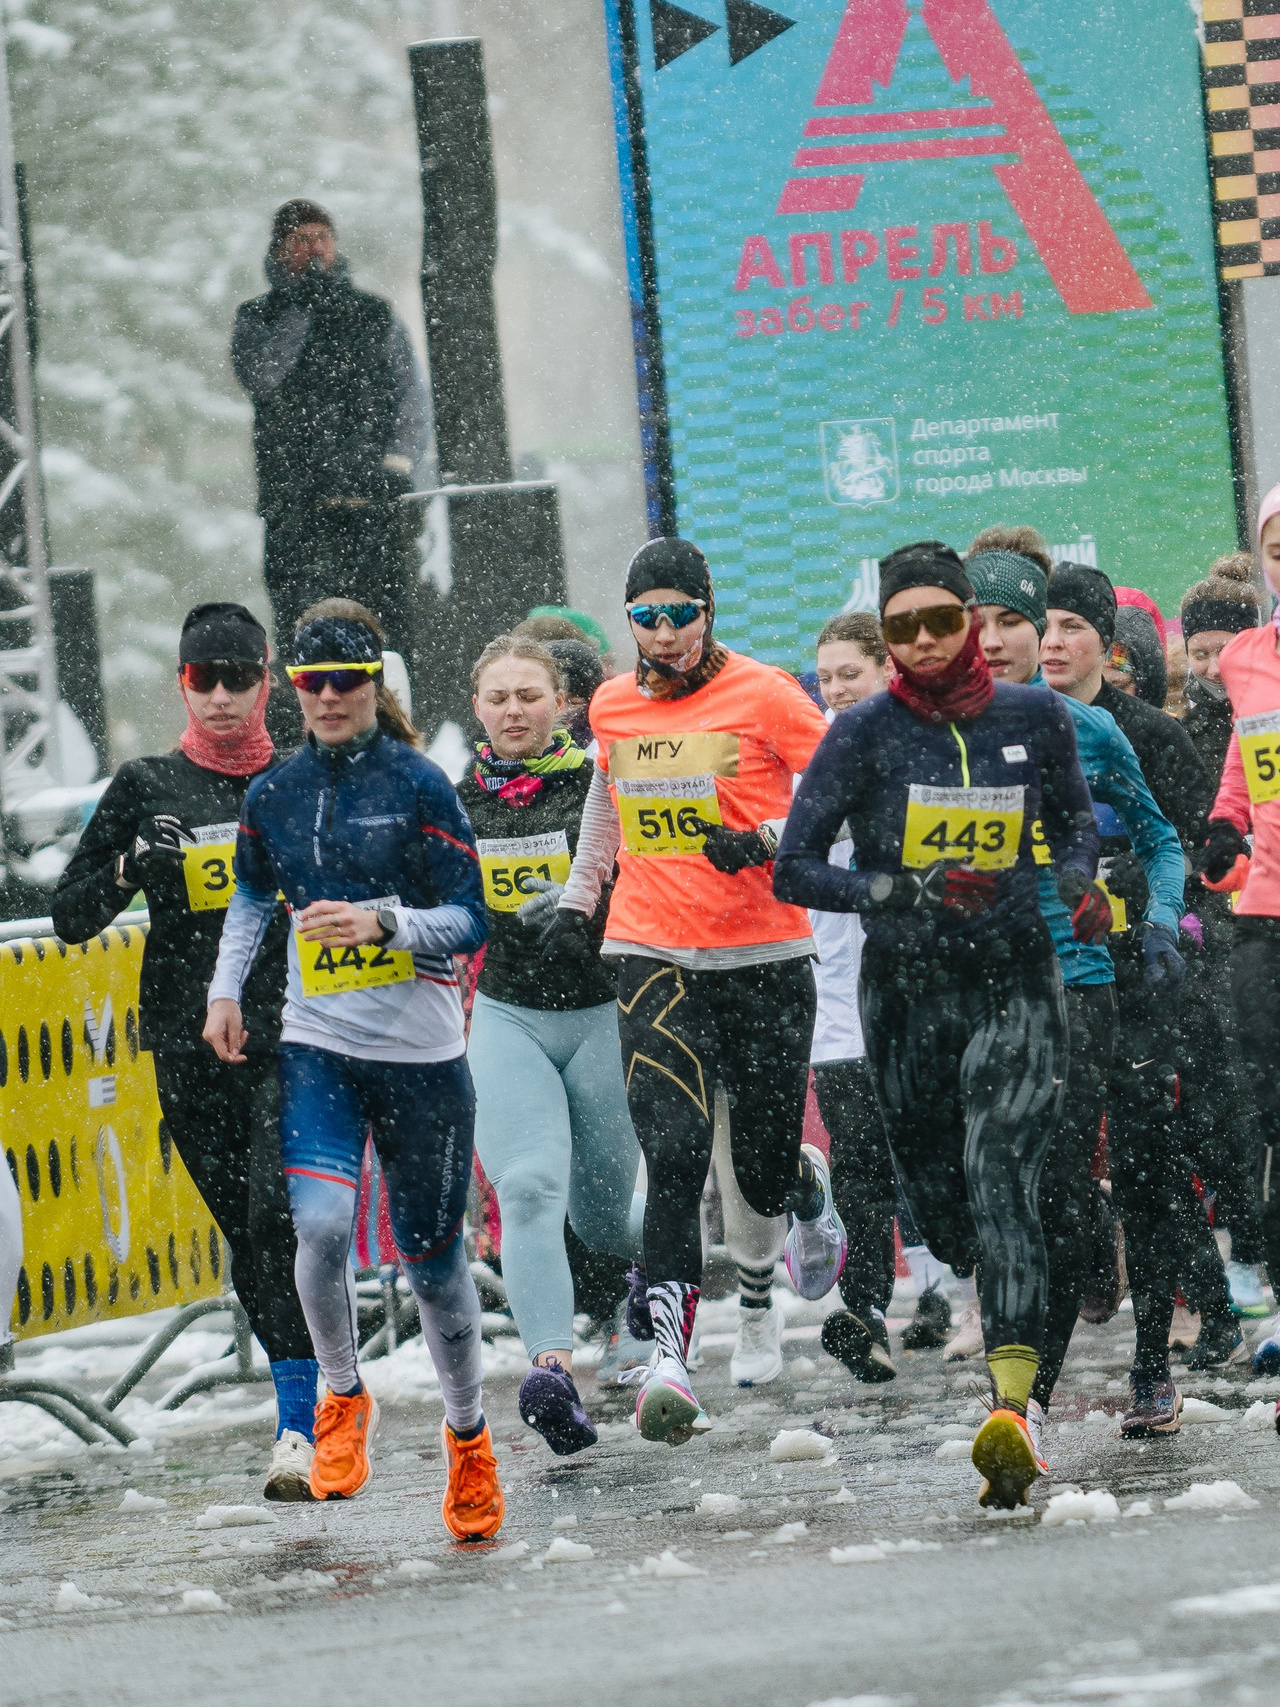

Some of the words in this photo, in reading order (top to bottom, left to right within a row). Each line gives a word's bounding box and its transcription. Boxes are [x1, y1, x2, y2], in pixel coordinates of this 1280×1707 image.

[733, 220, 1019, 291] АПРЕЛЬ
[734, 295, 870, 338] забег
[887, 289, 905, 328] /
[922, 286, 949, 326] 5
[964, 290, 1024, 322] км
[910, 412, 1060, 441] Департамент
[913, 444, 991, 467] спорта
[916, 470, 994, 496] города
[998, 465, 1088, 487] Москвы
[637, 740, 683, 760] МГУ
[680, 779, 706, 789] ЭТАП
[637, 806, 702, 839] 516
[920, 820, 1006, 852] 443
[532, 837, 557, 848] ЭТАП
[491, 862, 552, 897] 561
[313, 944, 396, 975] 442
